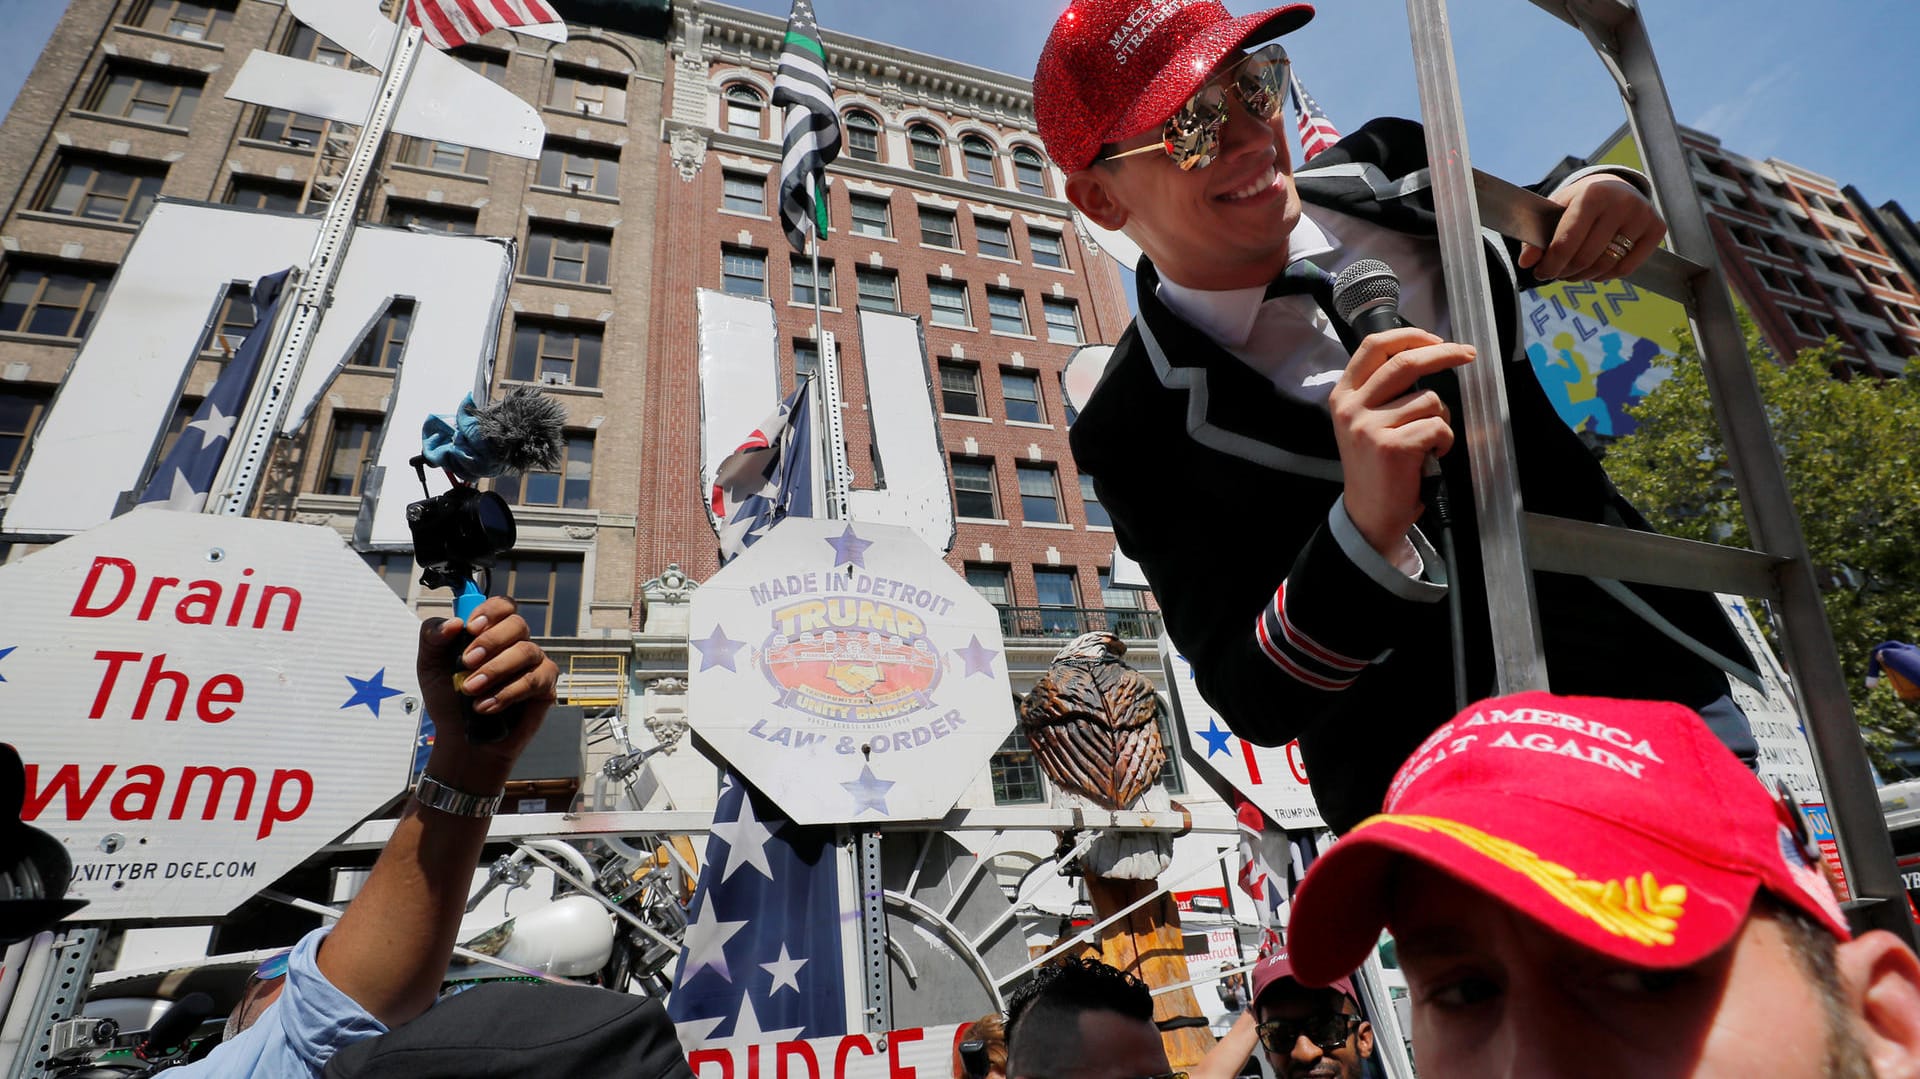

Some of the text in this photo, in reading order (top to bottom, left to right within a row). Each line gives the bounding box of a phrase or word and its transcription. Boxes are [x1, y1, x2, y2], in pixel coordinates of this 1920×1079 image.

[1109, 6, 1150, 50] MAKE
[70, 556, 303, 632] Drain
[749, 572, 955, 617] MADE IN DETROIT
[774, 598, 926, 638] TRUMP
[88, 650, 245, 724] The
[796, 694, 922, 721] UNITY BRIDGE
[748, 708, 968, 755] LAW & ORDER
[1461, 707, 1665, 764] AMERICA
[1488, 730, 1646, 780] AGAIN
[20, 763, 314, 841] wamp
